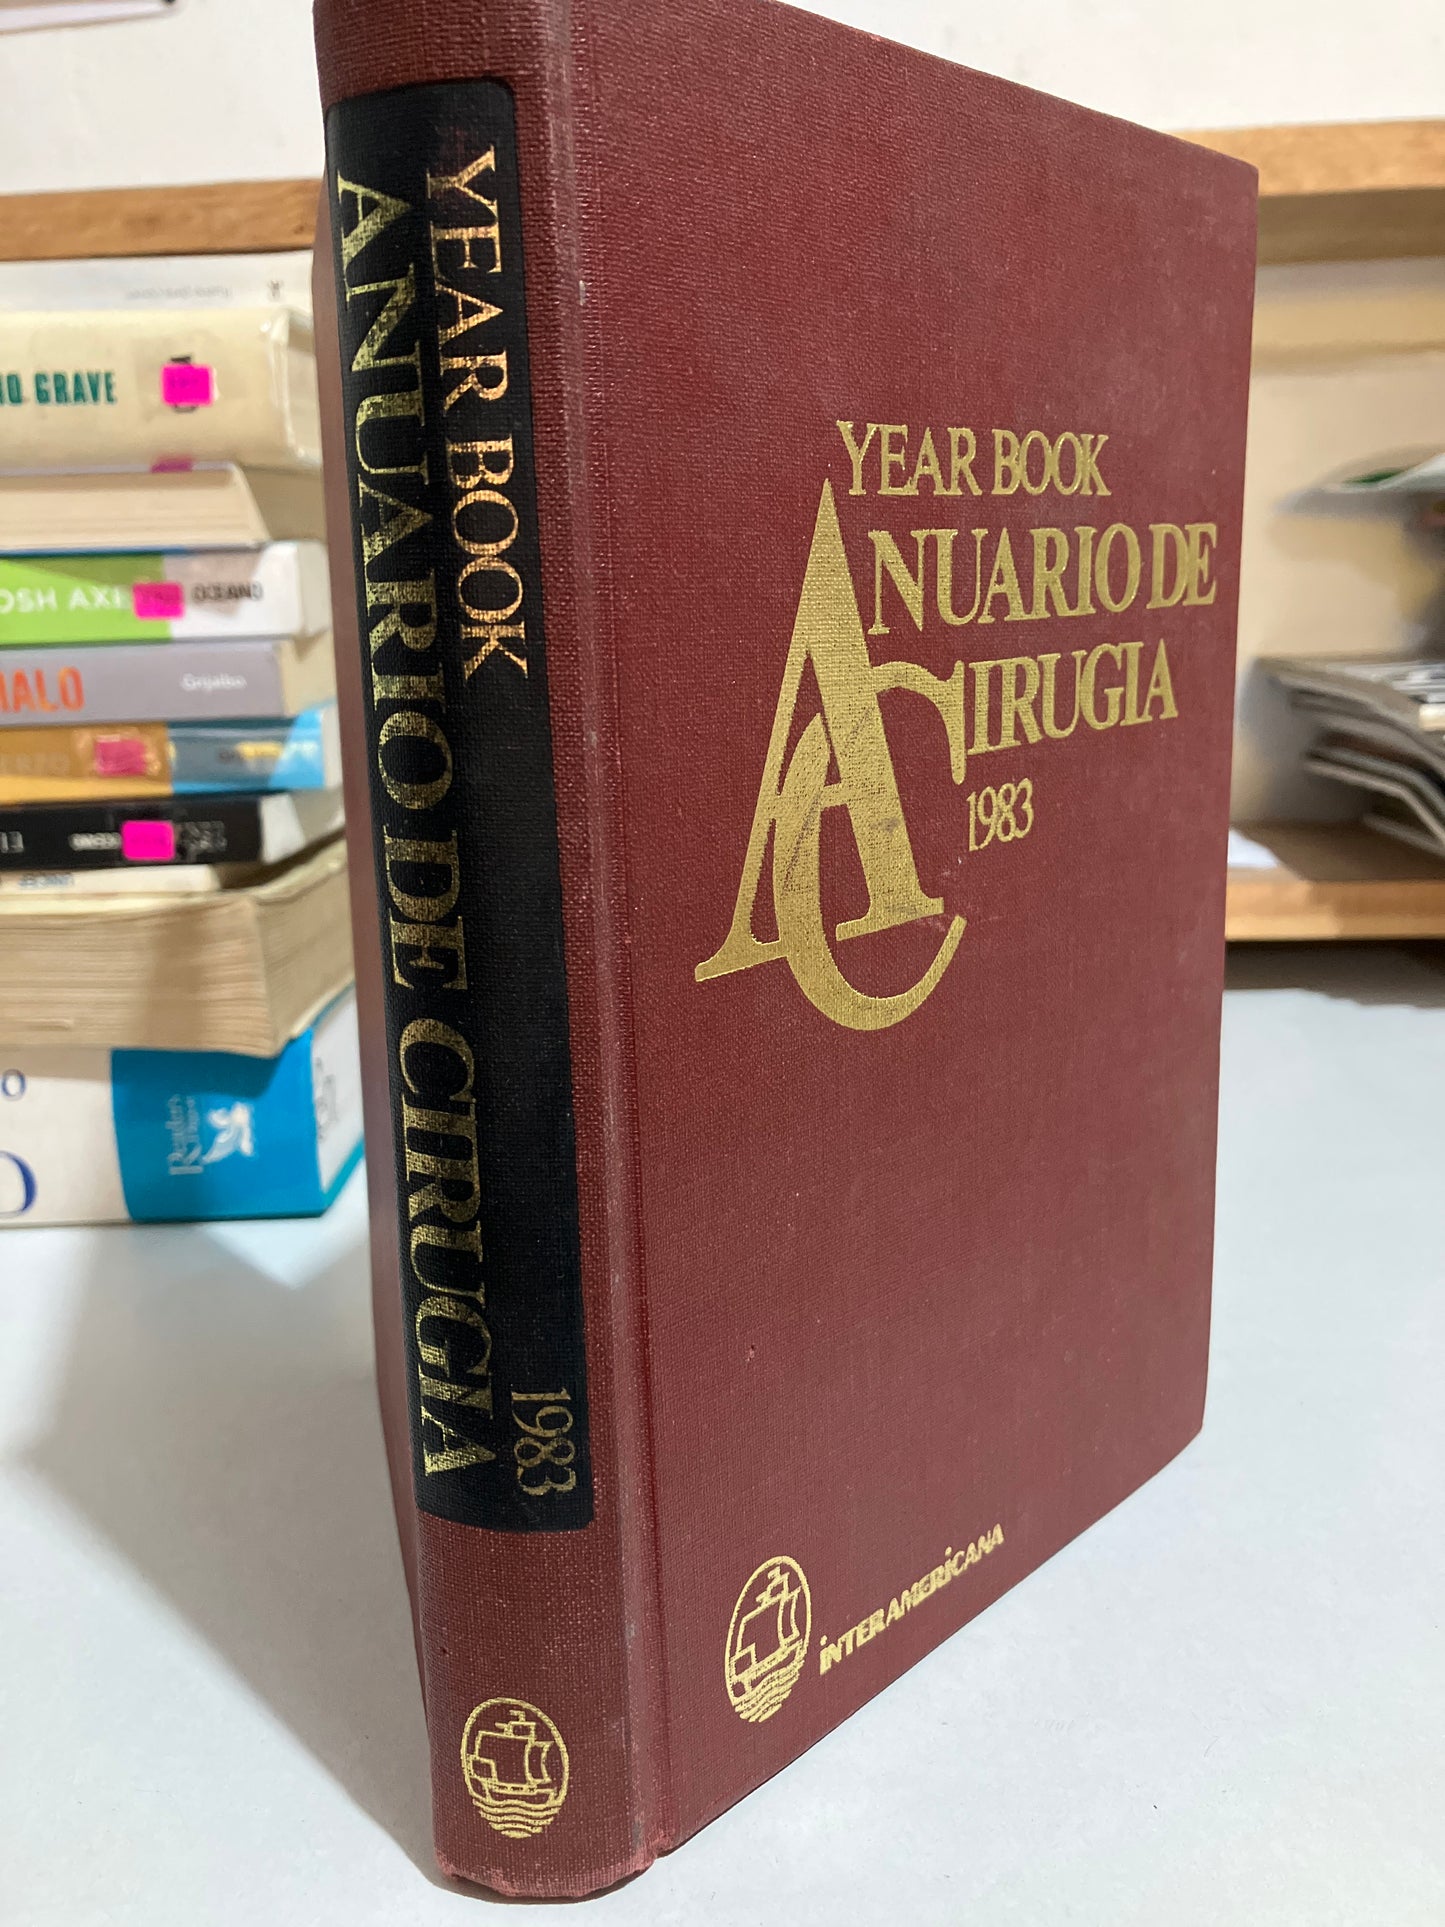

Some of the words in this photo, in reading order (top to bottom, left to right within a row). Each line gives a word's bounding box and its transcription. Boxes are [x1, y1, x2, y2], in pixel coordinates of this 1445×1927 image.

[426, 145, 509, 415] YEAR
[34, 371, 116, 405] GRAVE
[335, 167, 454, 810] ANUARIO
[836, 420, 985, 497] YEAR
[991, 431, 1112, 497] BOOK
[445, 432, 529, 681] BOOK
[1146, 522, 1219, 609] DE
[966, 778, 1035, 852] 1983
[383, 825, 468, 991] DE
[400, 1016, 497, 1478] CIRUGIA
[509, 1388, 578, 1498] 1983
